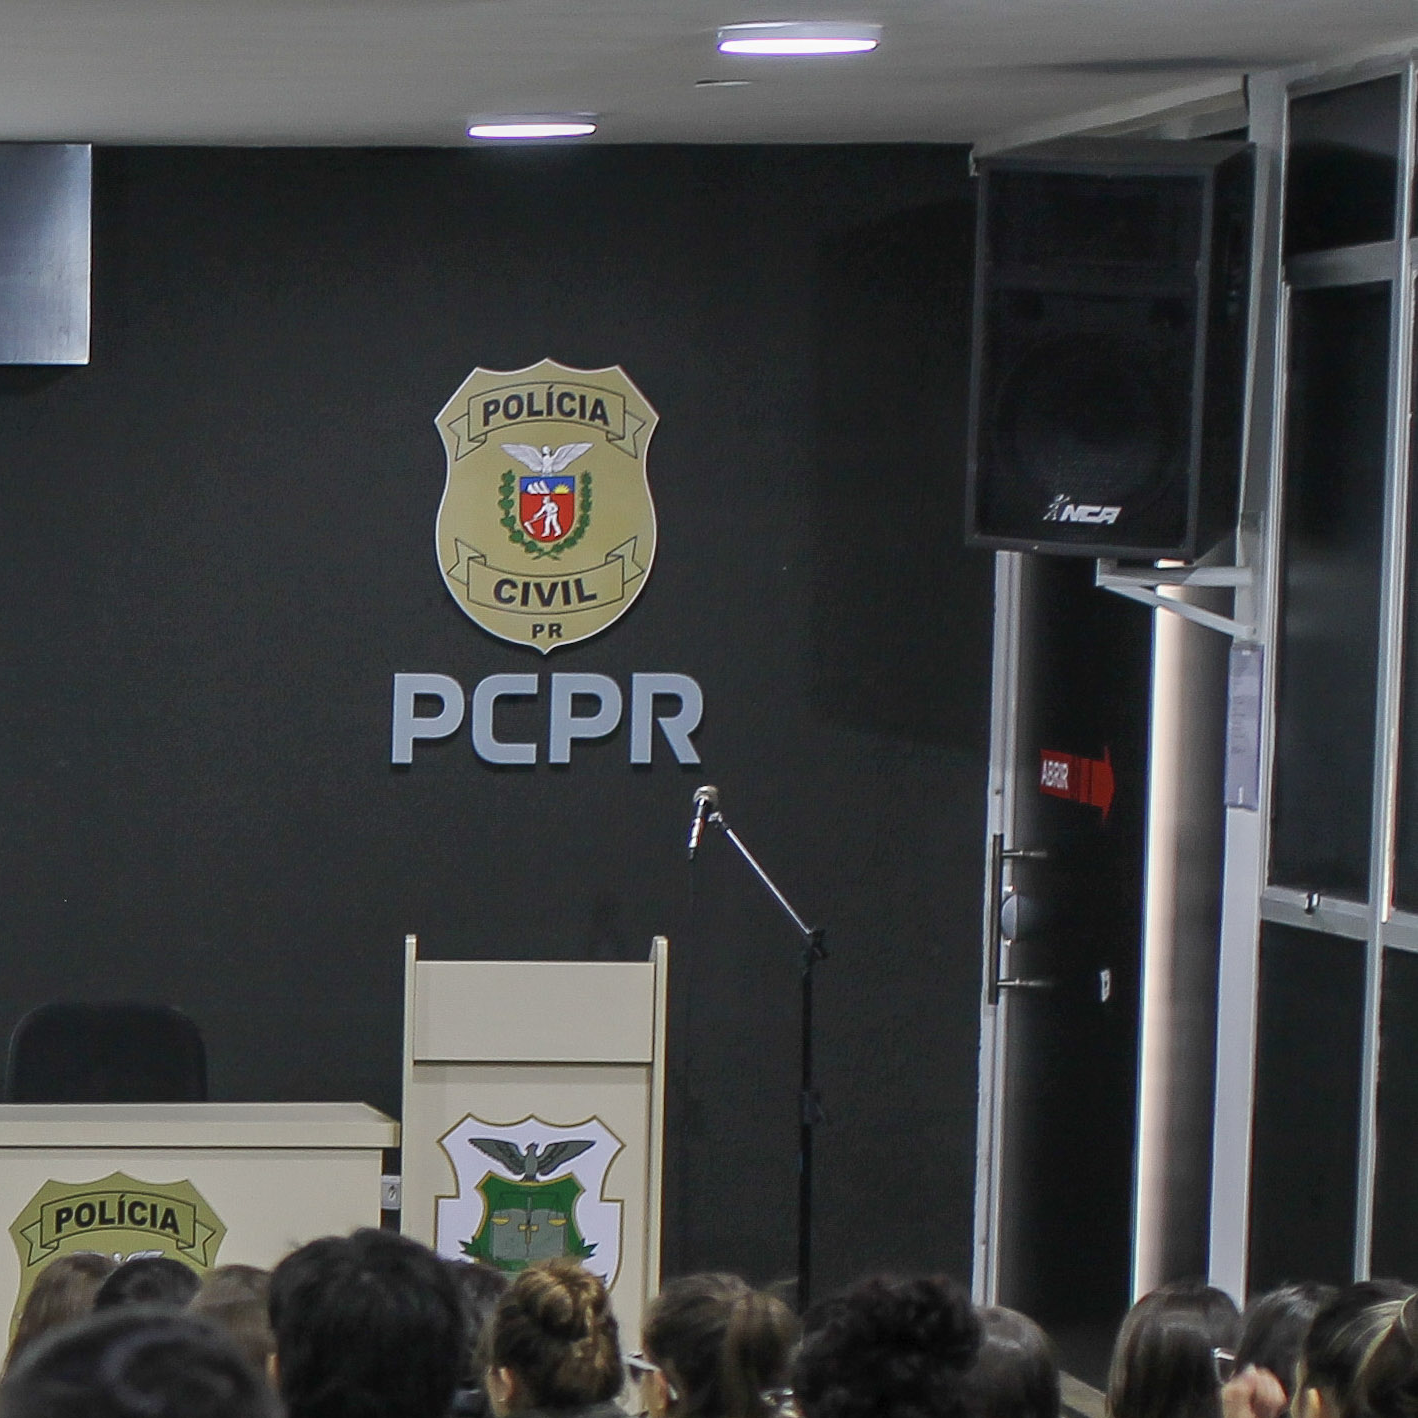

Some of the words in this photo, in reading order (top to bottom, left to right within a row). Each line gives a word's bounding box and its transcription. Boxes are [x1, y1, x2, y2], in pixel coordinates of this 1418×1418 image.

[482, 385, 610, 427] POLÍCIA
[1060, 504, 1122, 525] NCA
[493, 578, 598, 608] CIVIL
[531, 623, 564, 639] PR
[391, 672, 704, 765] PCPR
[54, 1193, 181, 1235] POLÍCIA
